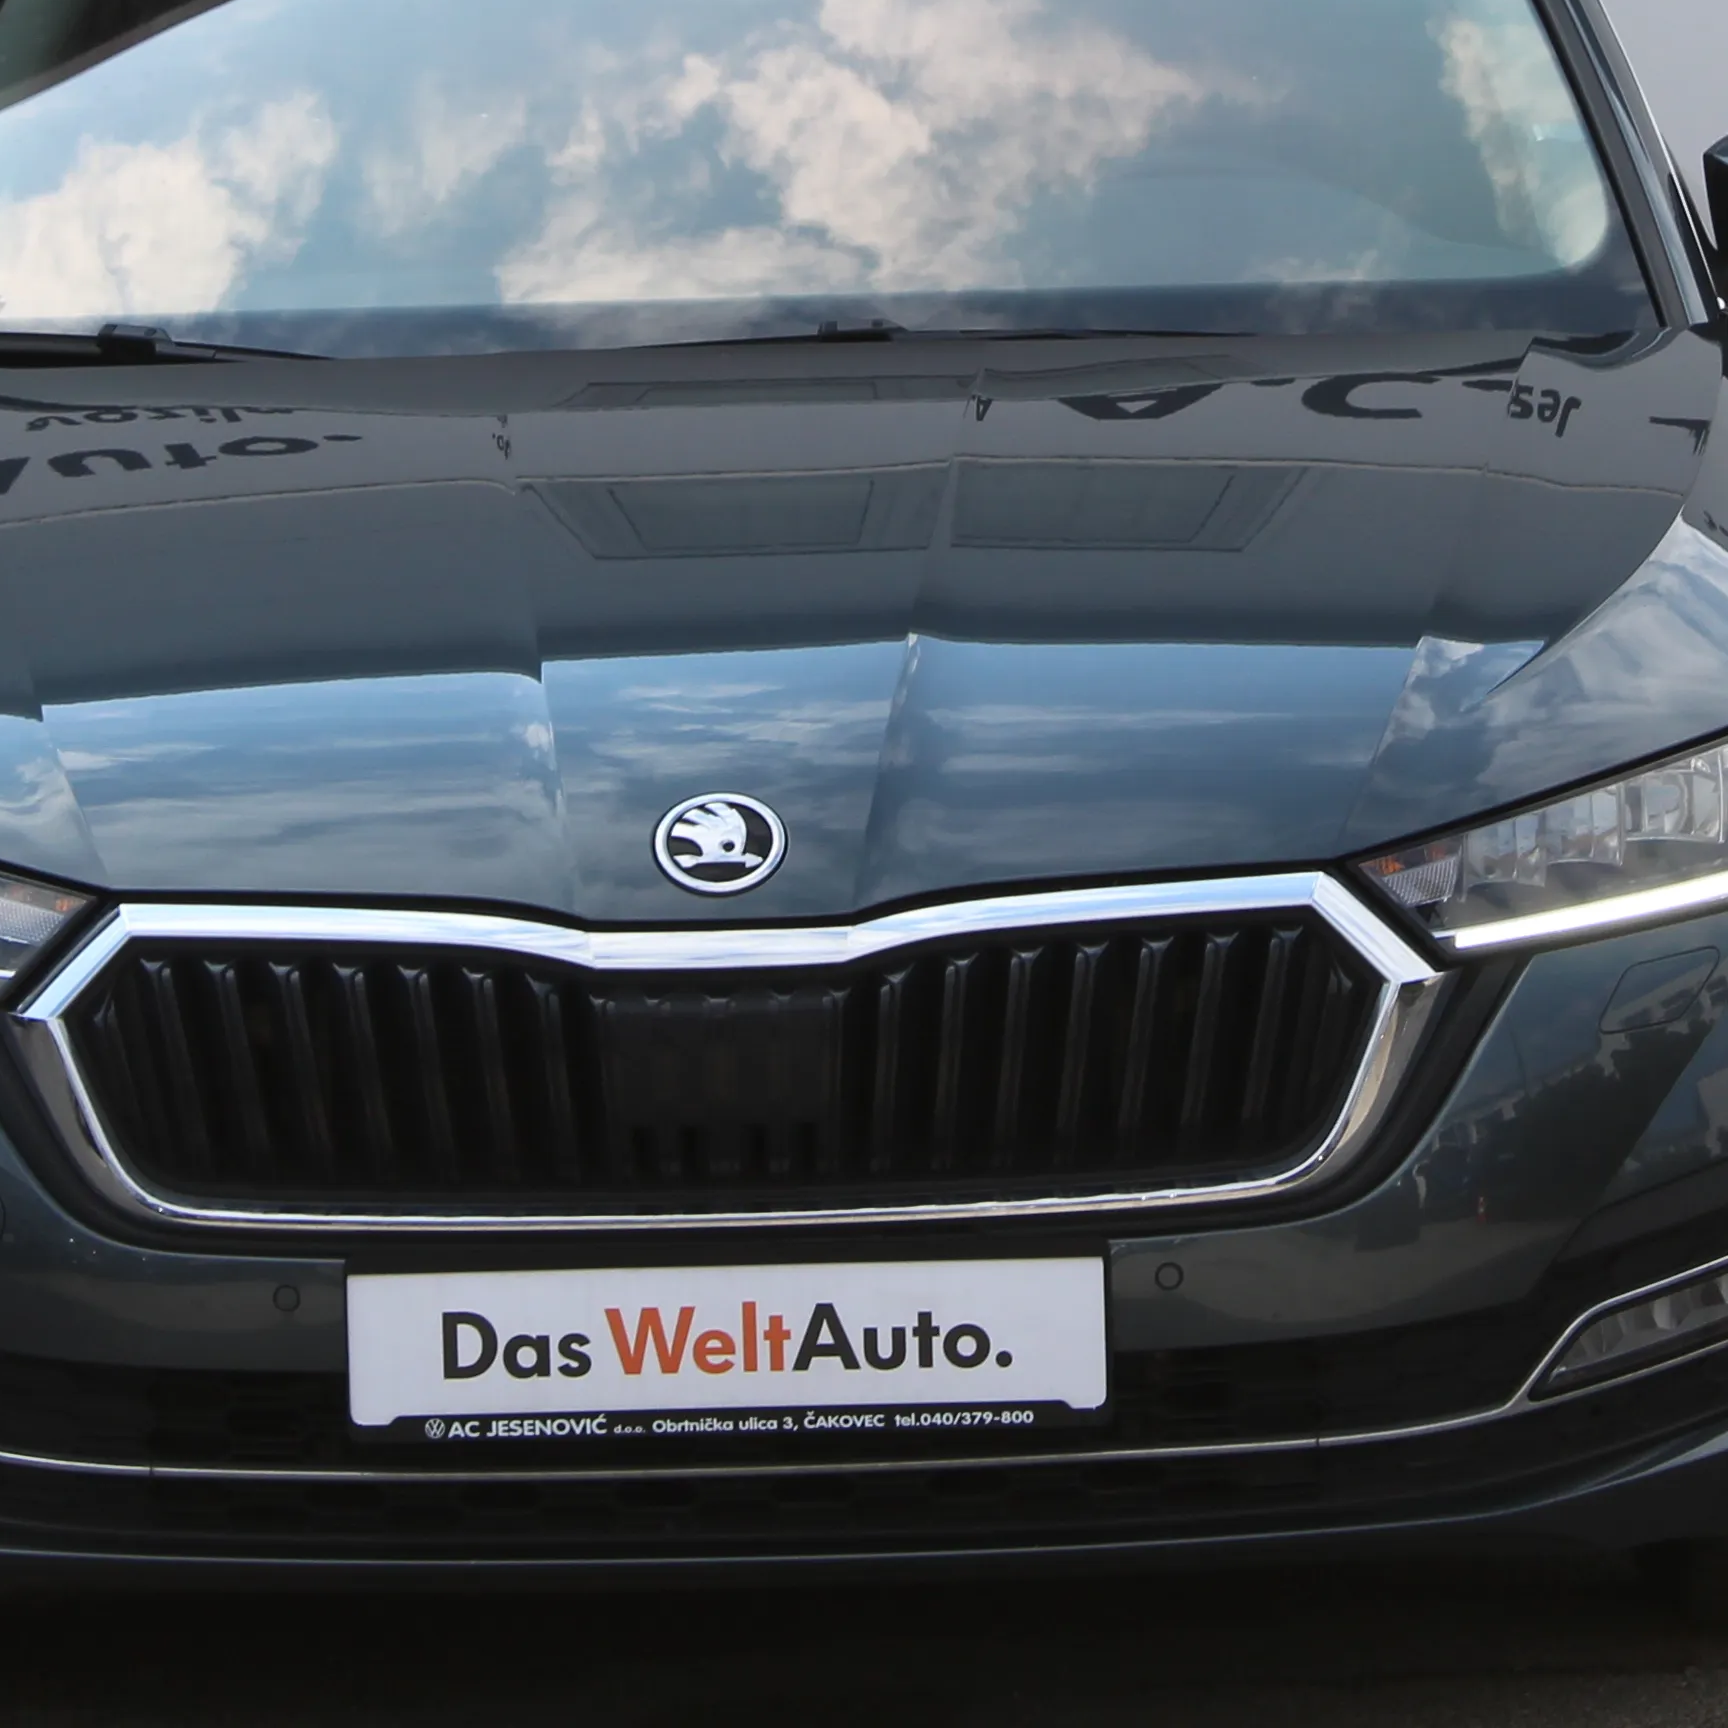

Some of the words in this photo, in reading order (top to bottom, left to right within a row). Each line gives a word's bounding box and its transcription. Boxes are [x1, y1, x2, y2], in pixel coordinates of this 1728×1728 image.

[440, 1310, 592, 1381] Das
[604, 1301, 1014, 1377] WeltAuto.
[447, 1421, 480, 1439] AC
[485, 1413, 608, 1438] JESENOVIĆ
[613, 1424, 646, 1435] d.o.o.
[651, 1417, 734, 1434] Obrtnička
[738, 1416, 778, 1431] ulica
[782, 1416, 799, 1432] 3,
[803, 1410, 885, 1430] ČAKOVEC
[894, 1410, 1035, 1428] tel.040/379-800
